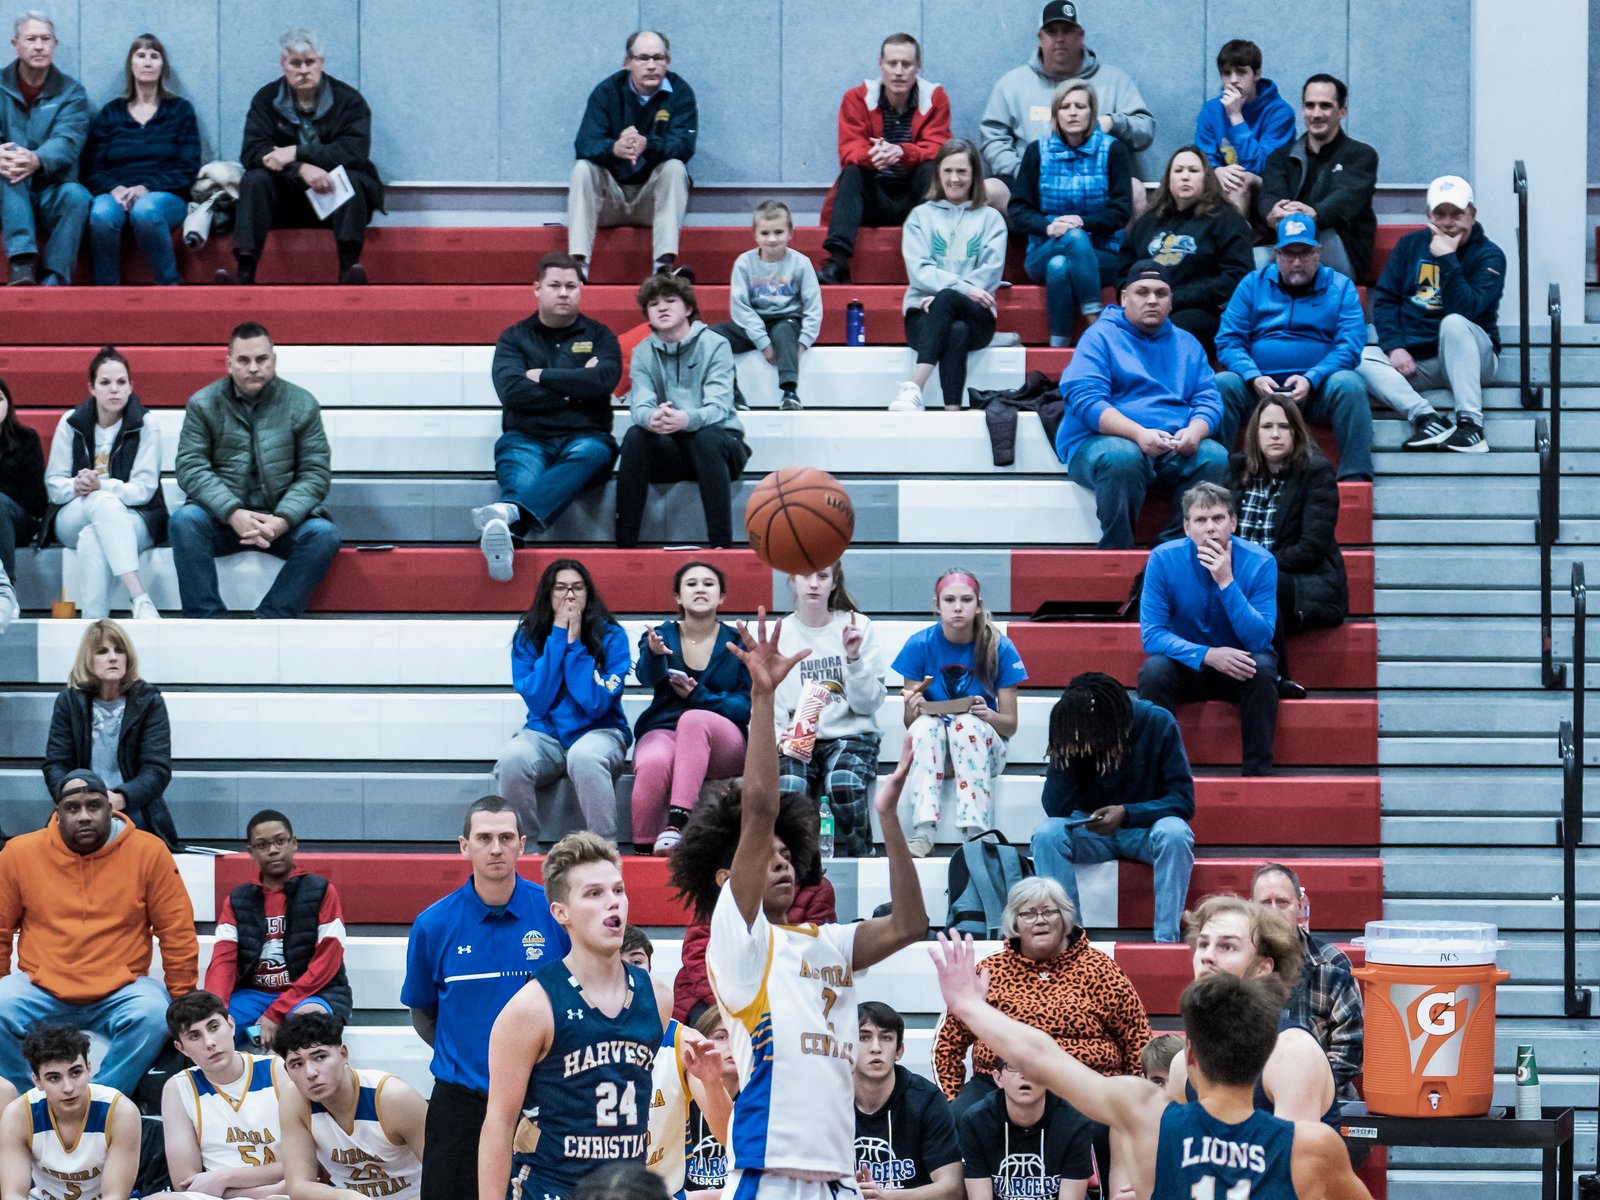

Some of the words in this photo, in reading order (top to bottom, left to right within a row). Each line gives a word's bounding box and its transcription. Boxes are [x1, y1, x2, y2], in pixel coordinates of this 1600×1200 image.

[800, 655, 842, 672] AURORA
[1417, 991, 1456, 1036] G
[595, 1081, 638, 1127] 24
[563, 1133, 648, 1159] CHRISTIA
[1181, 1135, 1266, 1173] LIONS
